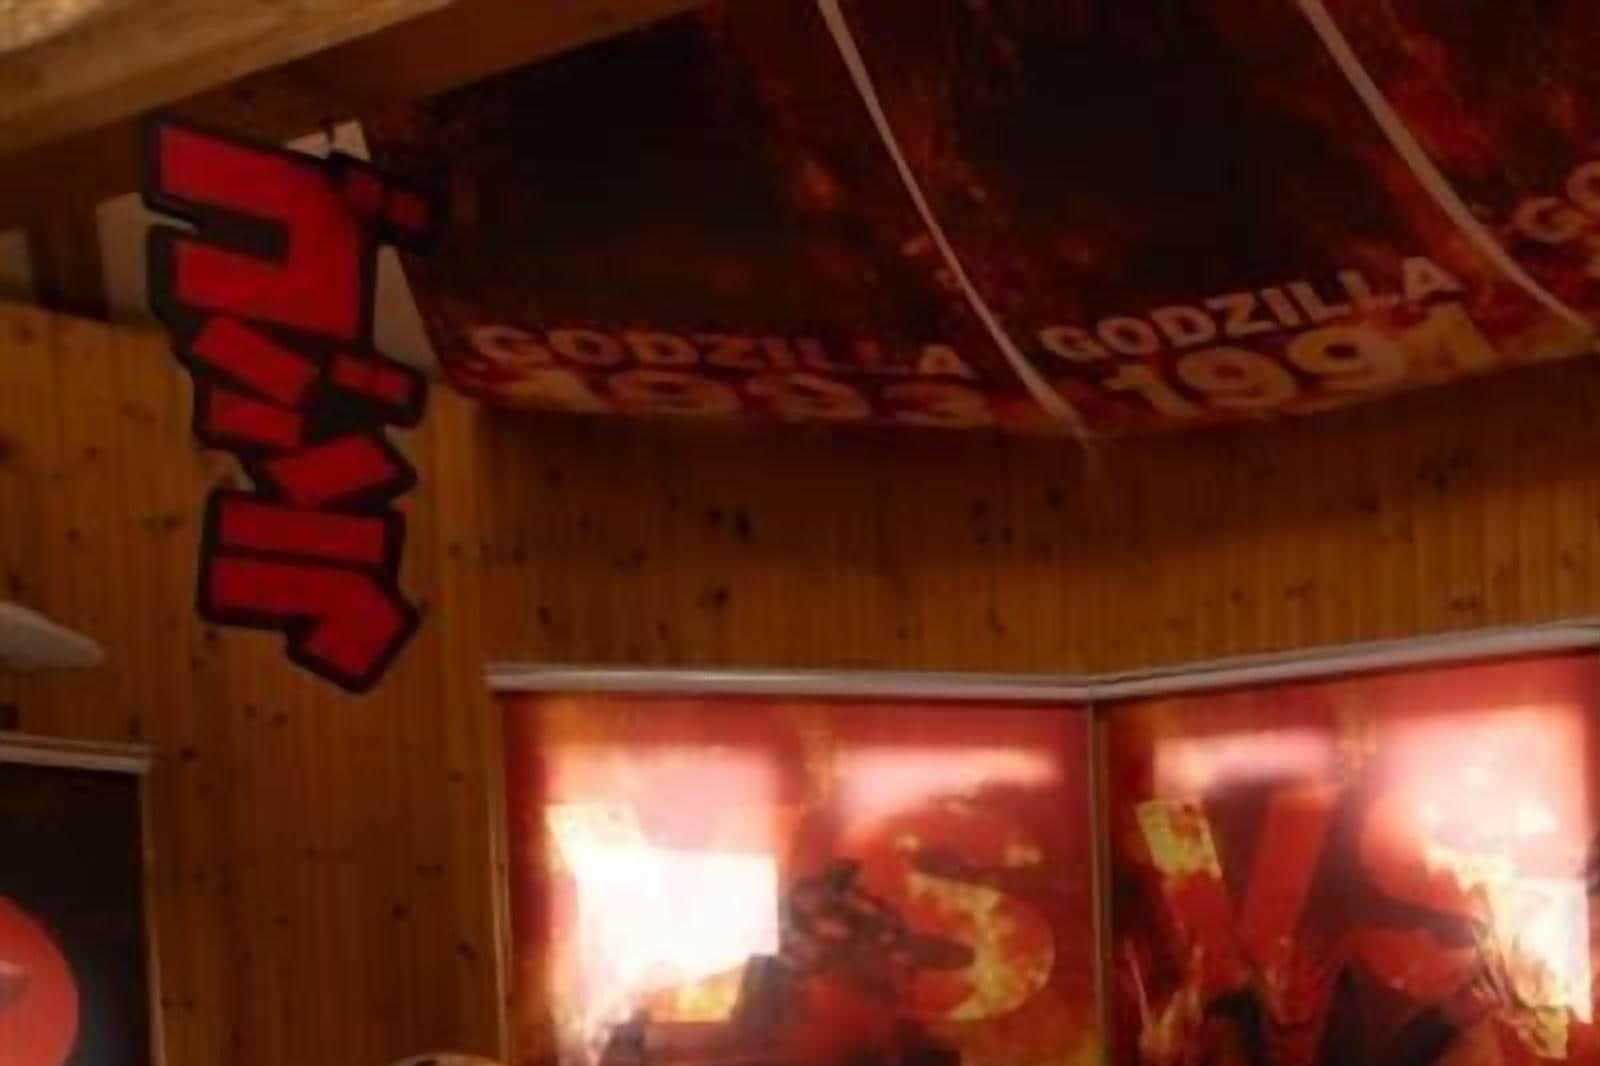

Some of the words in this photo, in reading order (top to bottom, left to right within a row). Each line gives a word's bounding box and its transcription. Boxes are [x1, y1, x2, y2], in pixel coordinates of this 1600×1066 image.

[466, 323, 982, 380] GODZILLA
[1040, 256, 1468, 365] GODZILLA
[1104, 303, 1492, 420] 1991
